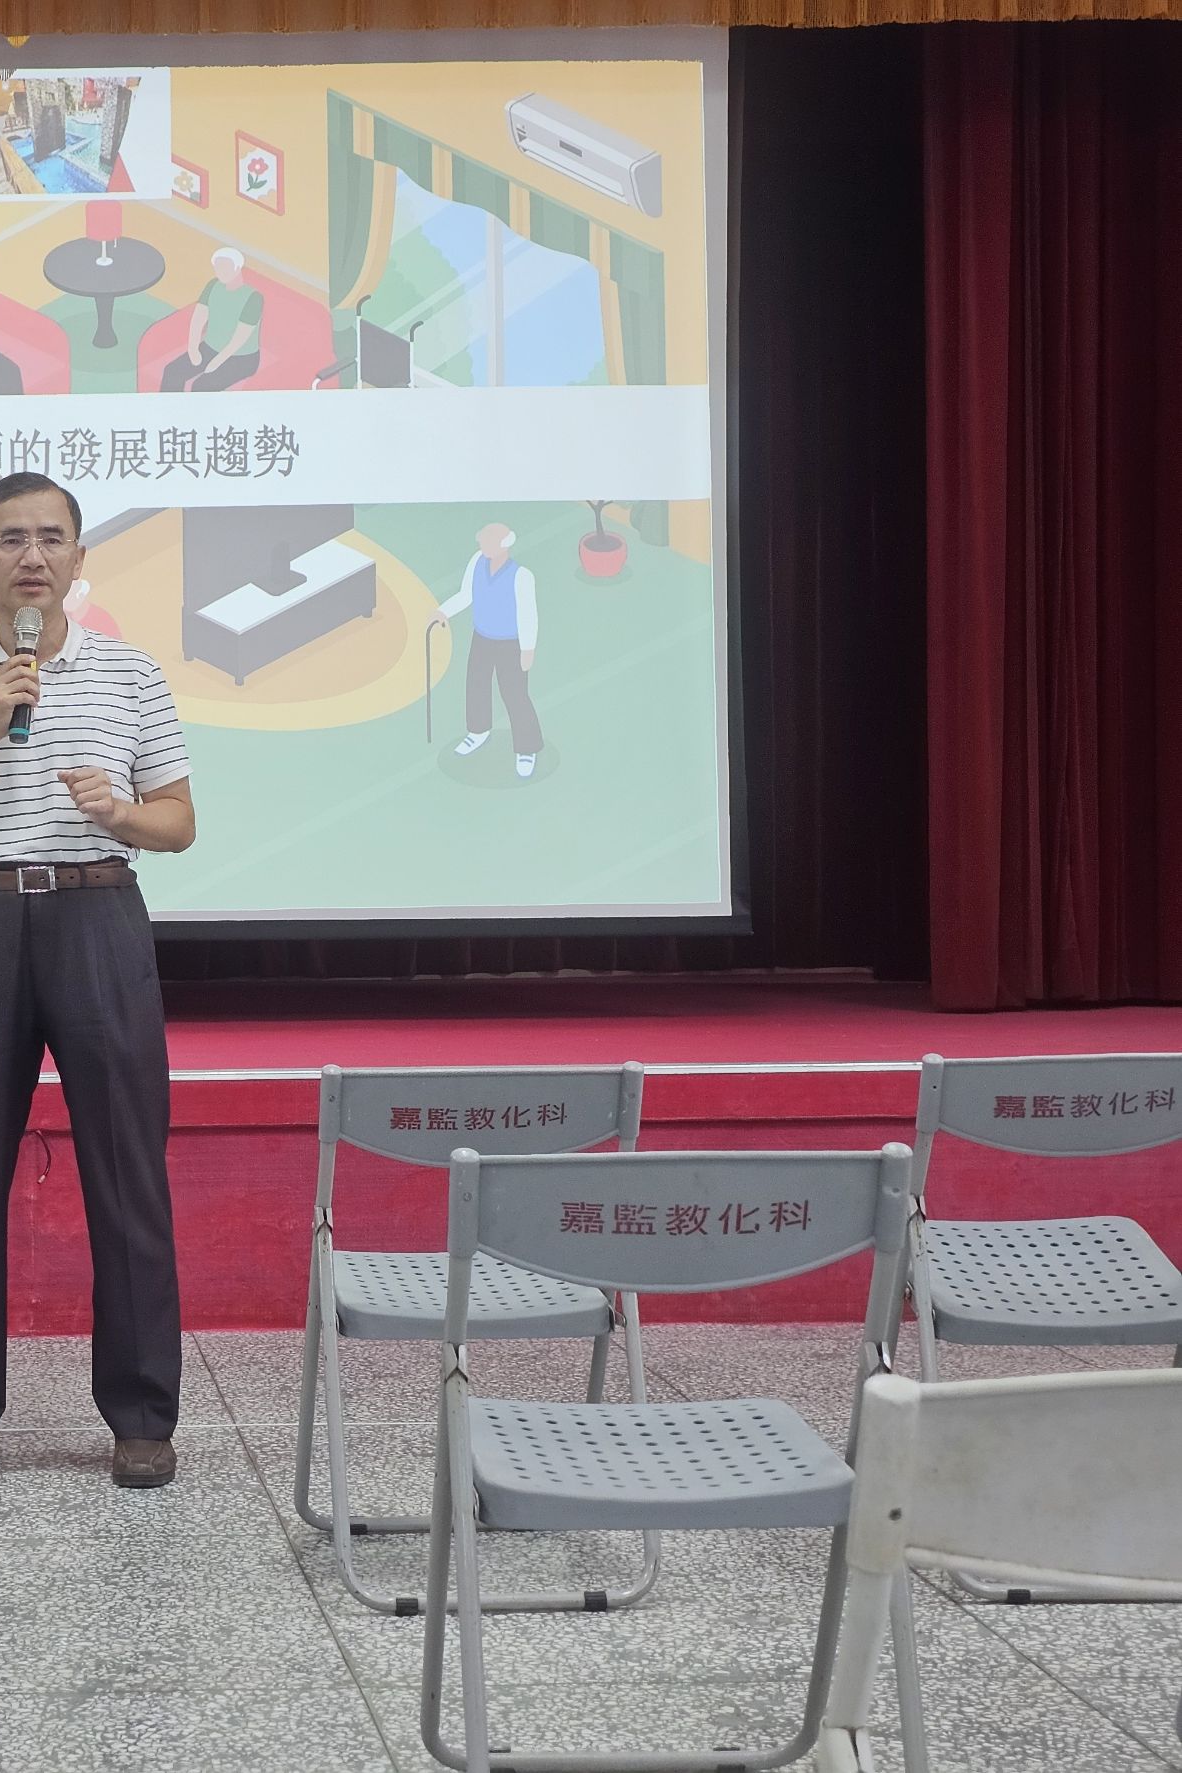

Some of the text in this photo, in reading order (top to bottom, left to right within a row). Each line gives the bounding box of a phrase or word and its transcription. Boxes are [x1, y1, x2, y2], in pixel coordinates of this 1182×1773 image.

[389, 1102, 568, 1131] 嘉監教化科
[993, 1086, 1176, 1119] 嘉監教化科
[559, 1199, 812, 1237] 嘉監教化科
